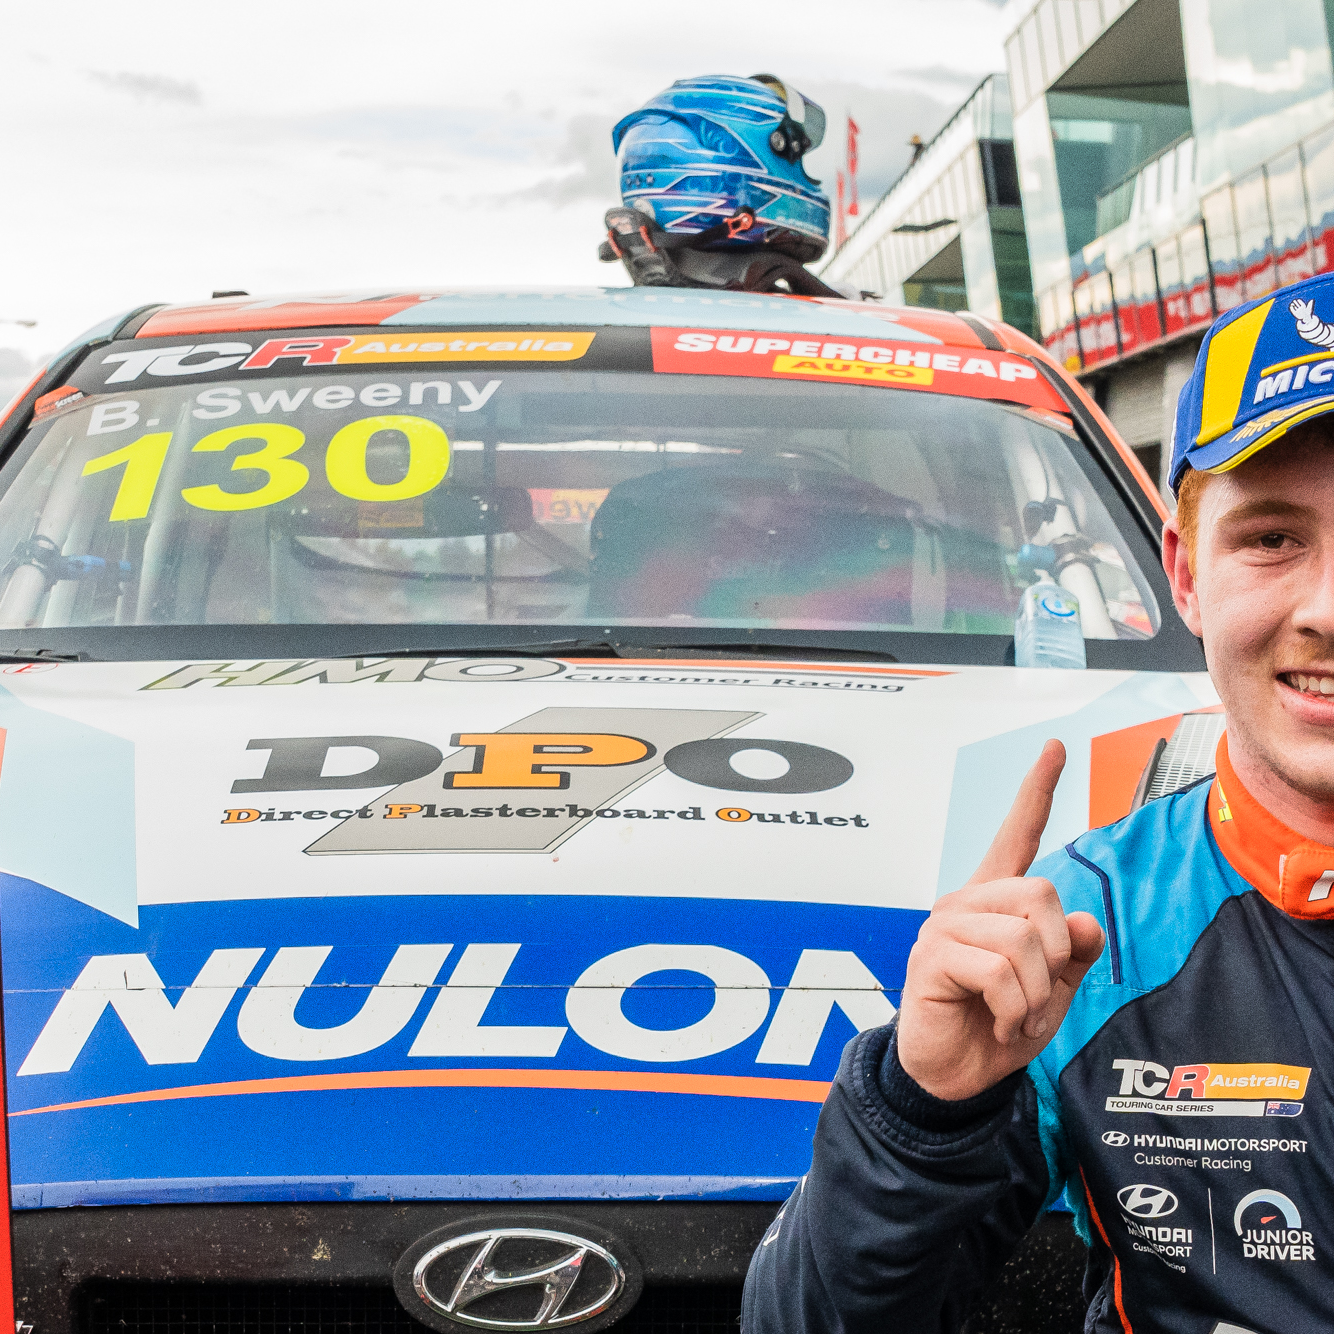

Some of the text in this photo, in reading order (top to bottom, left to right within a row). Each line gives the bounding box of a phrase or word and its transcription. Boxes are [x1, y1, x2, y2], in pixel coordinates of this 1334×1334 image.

[101, 335, 573, 384] TCR Australia
[675, 331, 1037, 385] SUPERCHEAP
[795, 358, 913, 380] AUTO
[87, 379, 503, 436] B. Sweeny
[81, 414, 451, 522] 130
[138, 658, 567, 691] HMO
[565, 672, 904, 693] Customer Racing
[230, 731, 855, 796] DPO
[220, 803, 870, 830] Direct Plasterboard Outlet
[1112, 1059, 1300, 1098] TCR Australia
[1110, 1100, 1214, 1112] TOURING CAR SERIES
[1134, 1153, 1252, 1171] Customer Racing
[1242, 1229, 1314, 1245] JUNIOR
[1243, 1243, 1316, 1261] DRIVER
